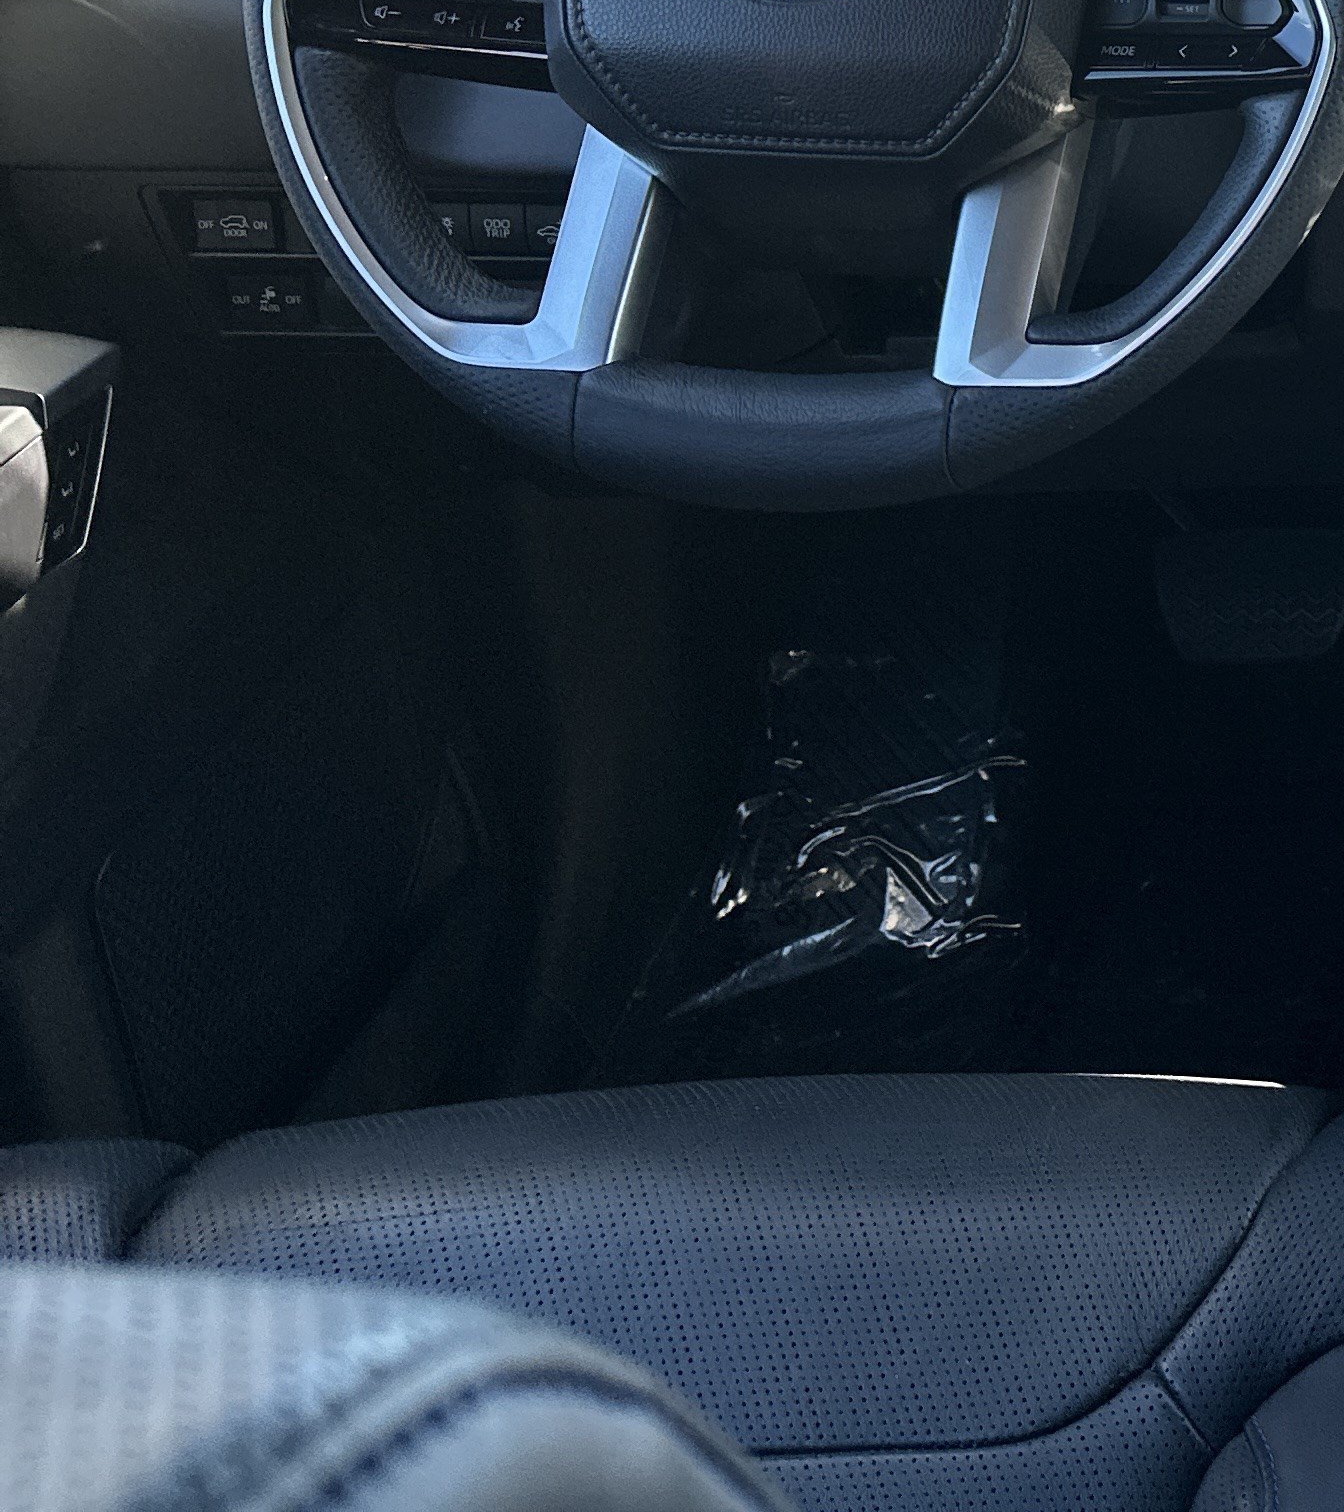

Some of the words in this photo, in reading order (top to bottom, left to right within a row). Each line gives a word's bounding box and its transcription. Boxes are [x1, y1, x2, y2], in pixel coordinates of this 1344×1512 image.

[1100, 45, 1136, 57] MODE
[197, 220, 215, 229] OFF
[252, 220, 268, 230] ON
[483, 219, 511, 229] ODO
[223, 229, 248, 238] DOOR
[486, 229, 511, 239] TRIP
